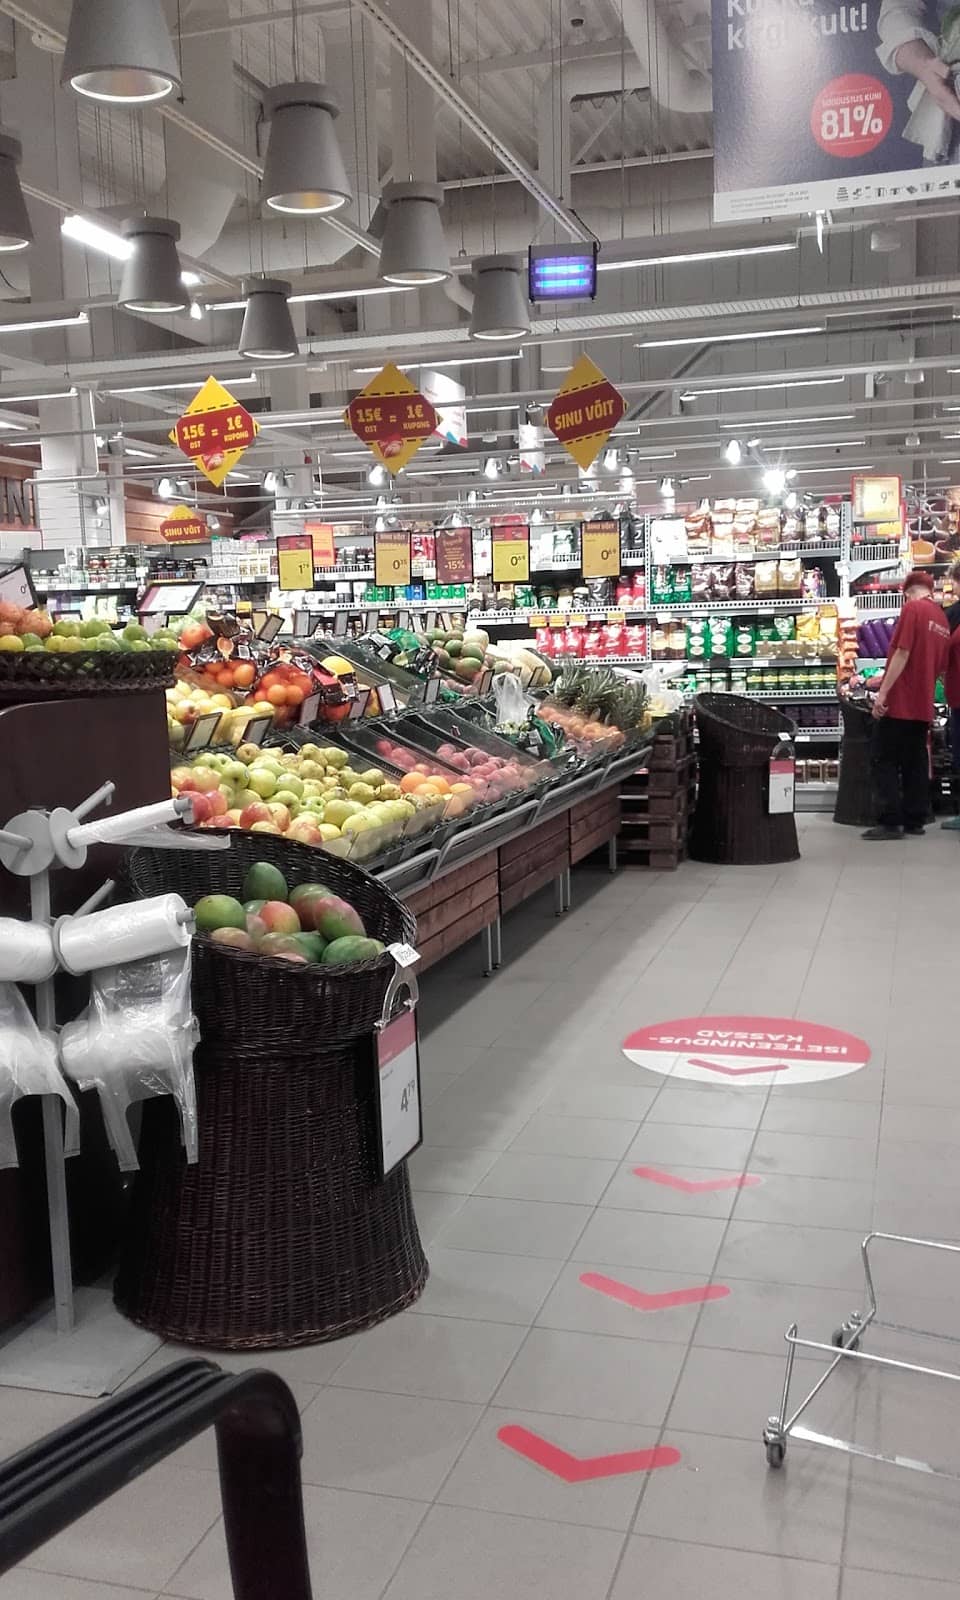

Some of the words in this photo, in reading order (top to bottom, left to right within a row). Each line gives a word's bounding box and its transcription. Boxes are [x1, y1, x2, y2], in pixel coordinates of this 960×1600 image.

[820, 103, 883, 141] 81%
[356, 407, 382, 423] 15€
[406, 404, 424, 419] 1€
[554, 408, 583, 431] SINU
[585, 398, 614, 421] VÕIT
[182, 423, 206, 440] 15€
[226, 415, 242, 431] 1€
[223, 430, 249, 442] KUPONG
[164, 525, 182, 538] SINU
[649, 1036, 848, 1055] ISETEENINDUS-
[696, 1029, 803, 1043] KASSAD
